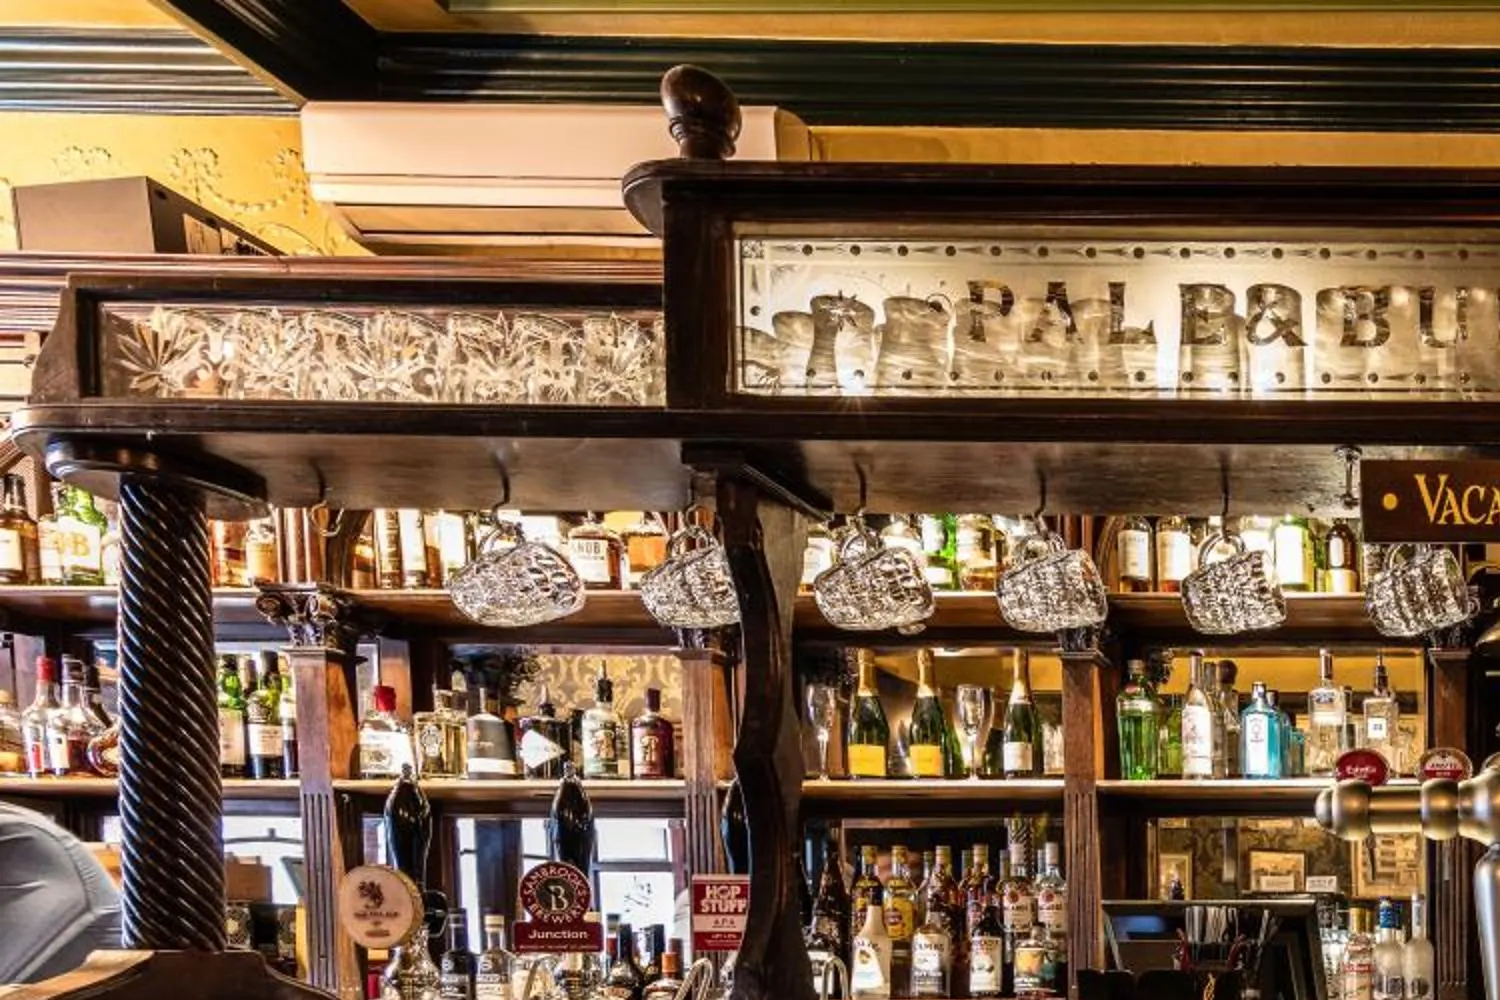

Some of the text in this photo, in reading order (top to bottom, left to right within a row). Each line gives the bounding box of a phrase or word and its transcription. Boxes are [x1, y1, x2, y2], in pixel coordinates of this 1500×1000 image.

[1245, 283, 1308, 348] &
[705, 885, 742, 899] HOP
[528, 929, 590, 940] Junction
